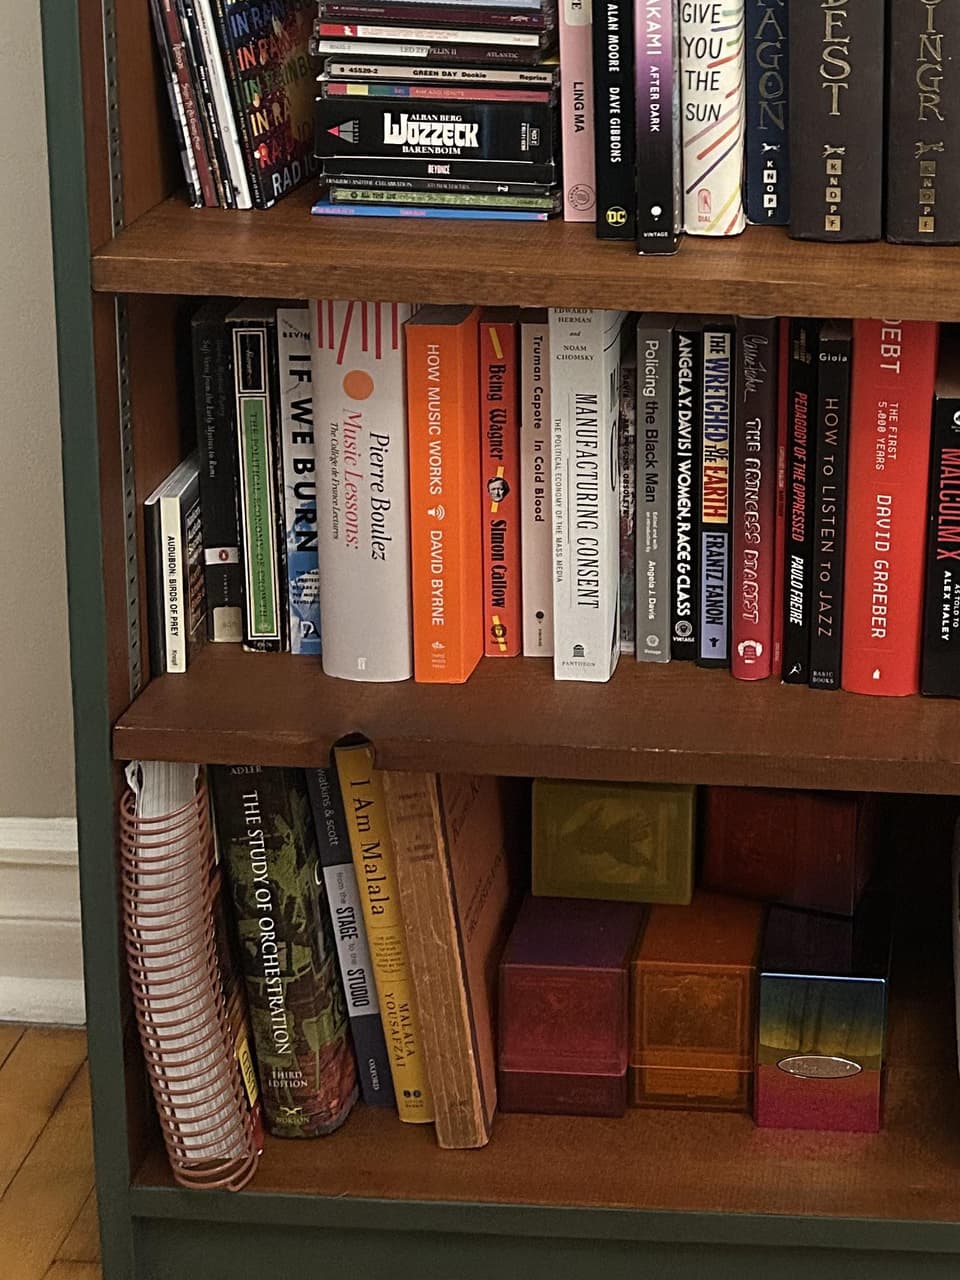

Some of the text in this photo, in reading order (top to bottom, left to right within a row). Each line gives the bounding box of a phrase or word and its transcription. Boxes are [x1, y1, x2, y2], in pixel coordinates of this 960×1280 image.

[682, 3, 722, 24] GIVE
[400, 46, 413, 54] LED
[683, 37, 723, 59] YOU
[413, 69, 439, 77] GREEN
[442, 70, 458, 78] DAY
[461, 71, 487, 79] Dookie
[685, 70, 720, 92] THE
[384, 112, 479, 148] WOZZECK
[410, 114, 463, 123] ALBAN BERG
[686, 103, 722, 122] SUN
[402, 145, 461, 155] BARENBOIM
[288, 355, 312, 383] IF
[290, 397, 315, 445] WE
[427, 345, 443, 495] HOW MUSIC WORKS
[292, 458, 318, 552] BURN
[369, 432, 393, 561] Pierre Boulez
[575, 393, 600, 609] MANUFACTURING CONSENT
[703, 465, 728, 519] EARTH
[430, 530, 445, 626] DAVID BYRNE
[705, 534, 725, 626] FRANTZ FANON
[871, 494, 892, 640] DAVID GRAEBER
[349, 779, 391, 917] I Am Malala
[241, 790, 291, 1055] THE STUDY OF ORCHESTRATION
[336, 906, 358, 942] STAGE
[347, 968, 370, 1008] STUDIO
[398, 1002, 417, 1058] MALALA
[267, 1079, 308, 1088] EDITION
[271, 1071, 304, 1080] THIRD
[367, 1057, 379, 1092] OXFORD
